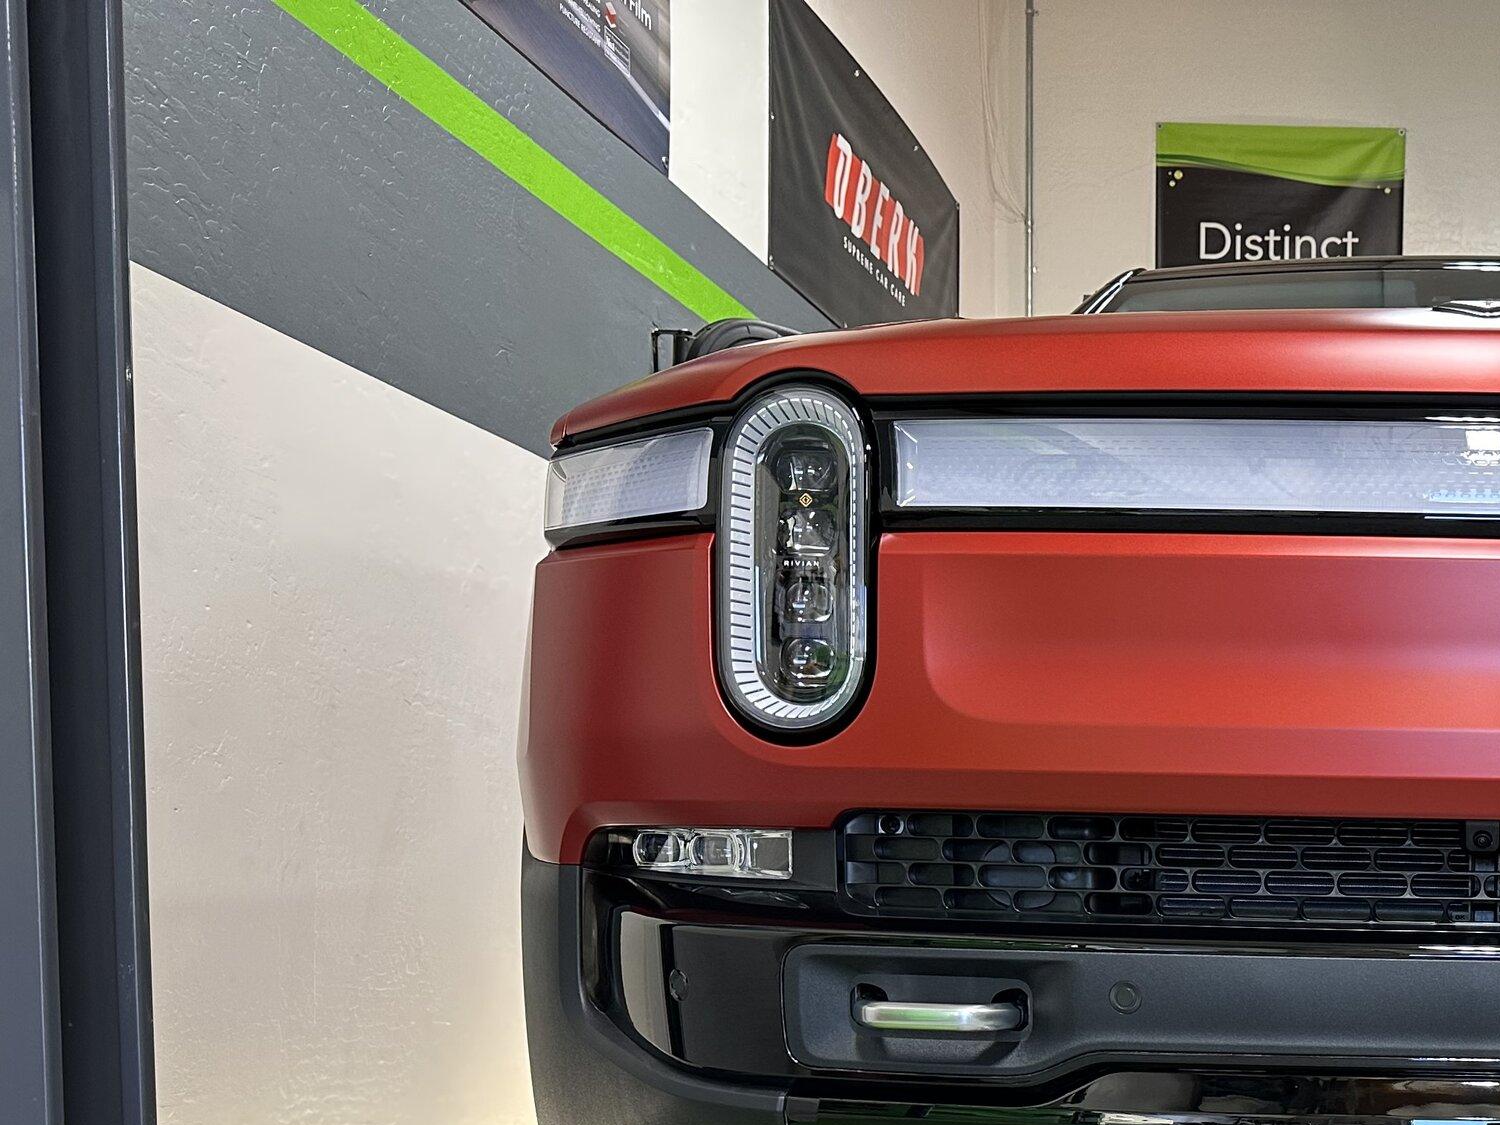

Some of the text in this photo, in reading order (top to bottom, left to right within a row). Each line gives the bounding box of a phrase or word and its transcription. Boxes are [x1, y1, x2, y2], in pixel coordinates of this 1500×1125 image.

[834, 133, 920, 296] OBERK
[1199, 221, 1360, 261] Distinct
[843, 236, 906, 308] SUPREME CAR CARE
